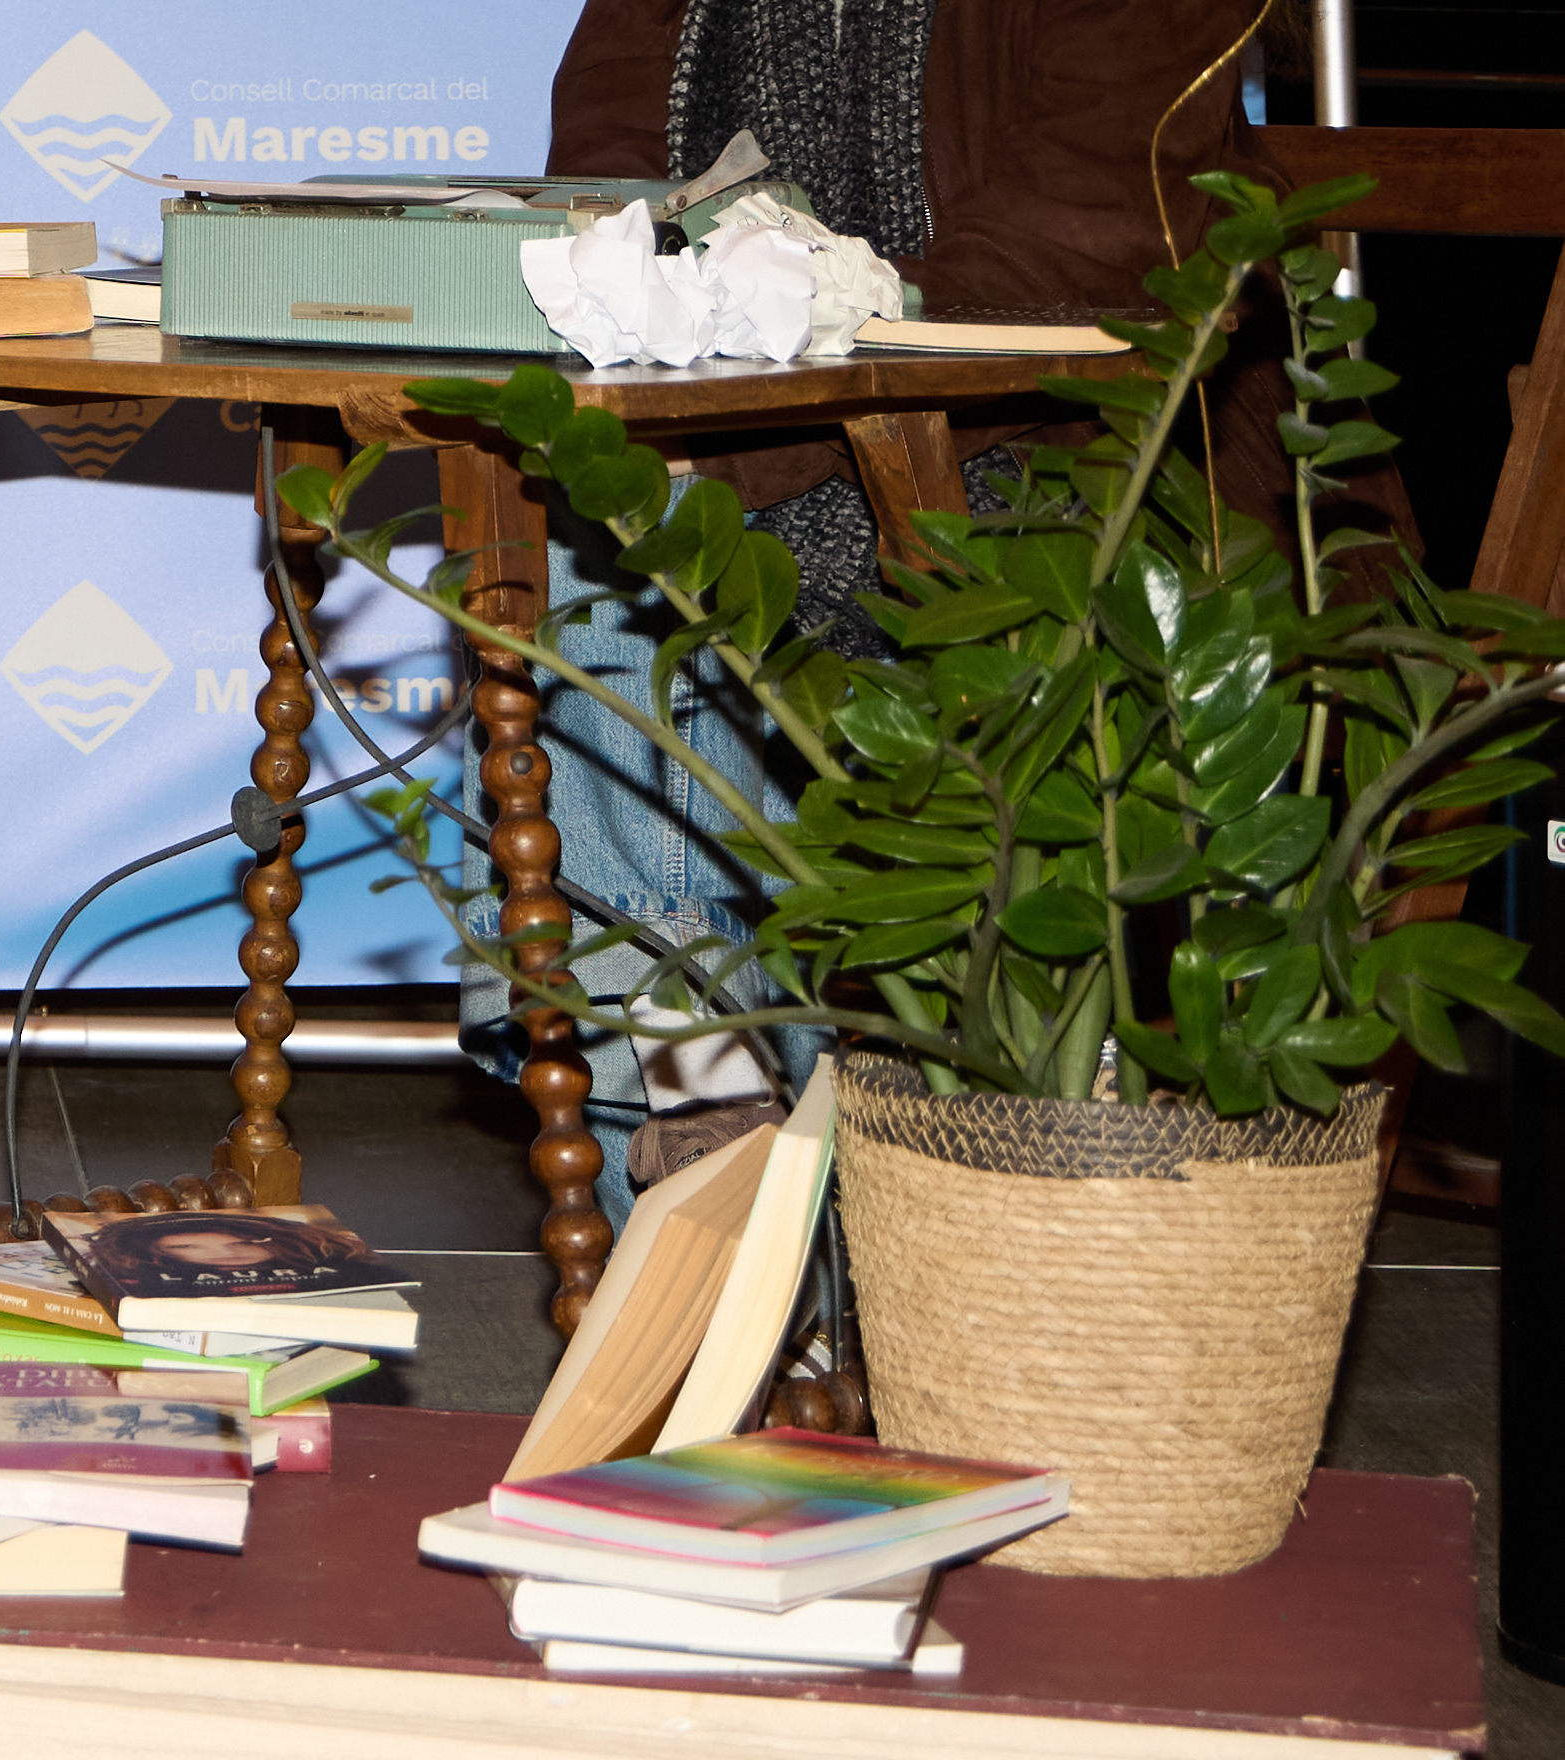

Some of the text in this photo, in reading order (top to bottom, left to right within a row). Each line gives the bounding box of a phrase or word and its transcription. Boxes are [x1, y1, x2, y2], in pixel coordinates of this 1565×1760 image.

[191, 78, 489, 103] Consell Comarcal del
[193, 116, 490, 162] Maresme
[159, 1266, 338, 1281] LAURA
